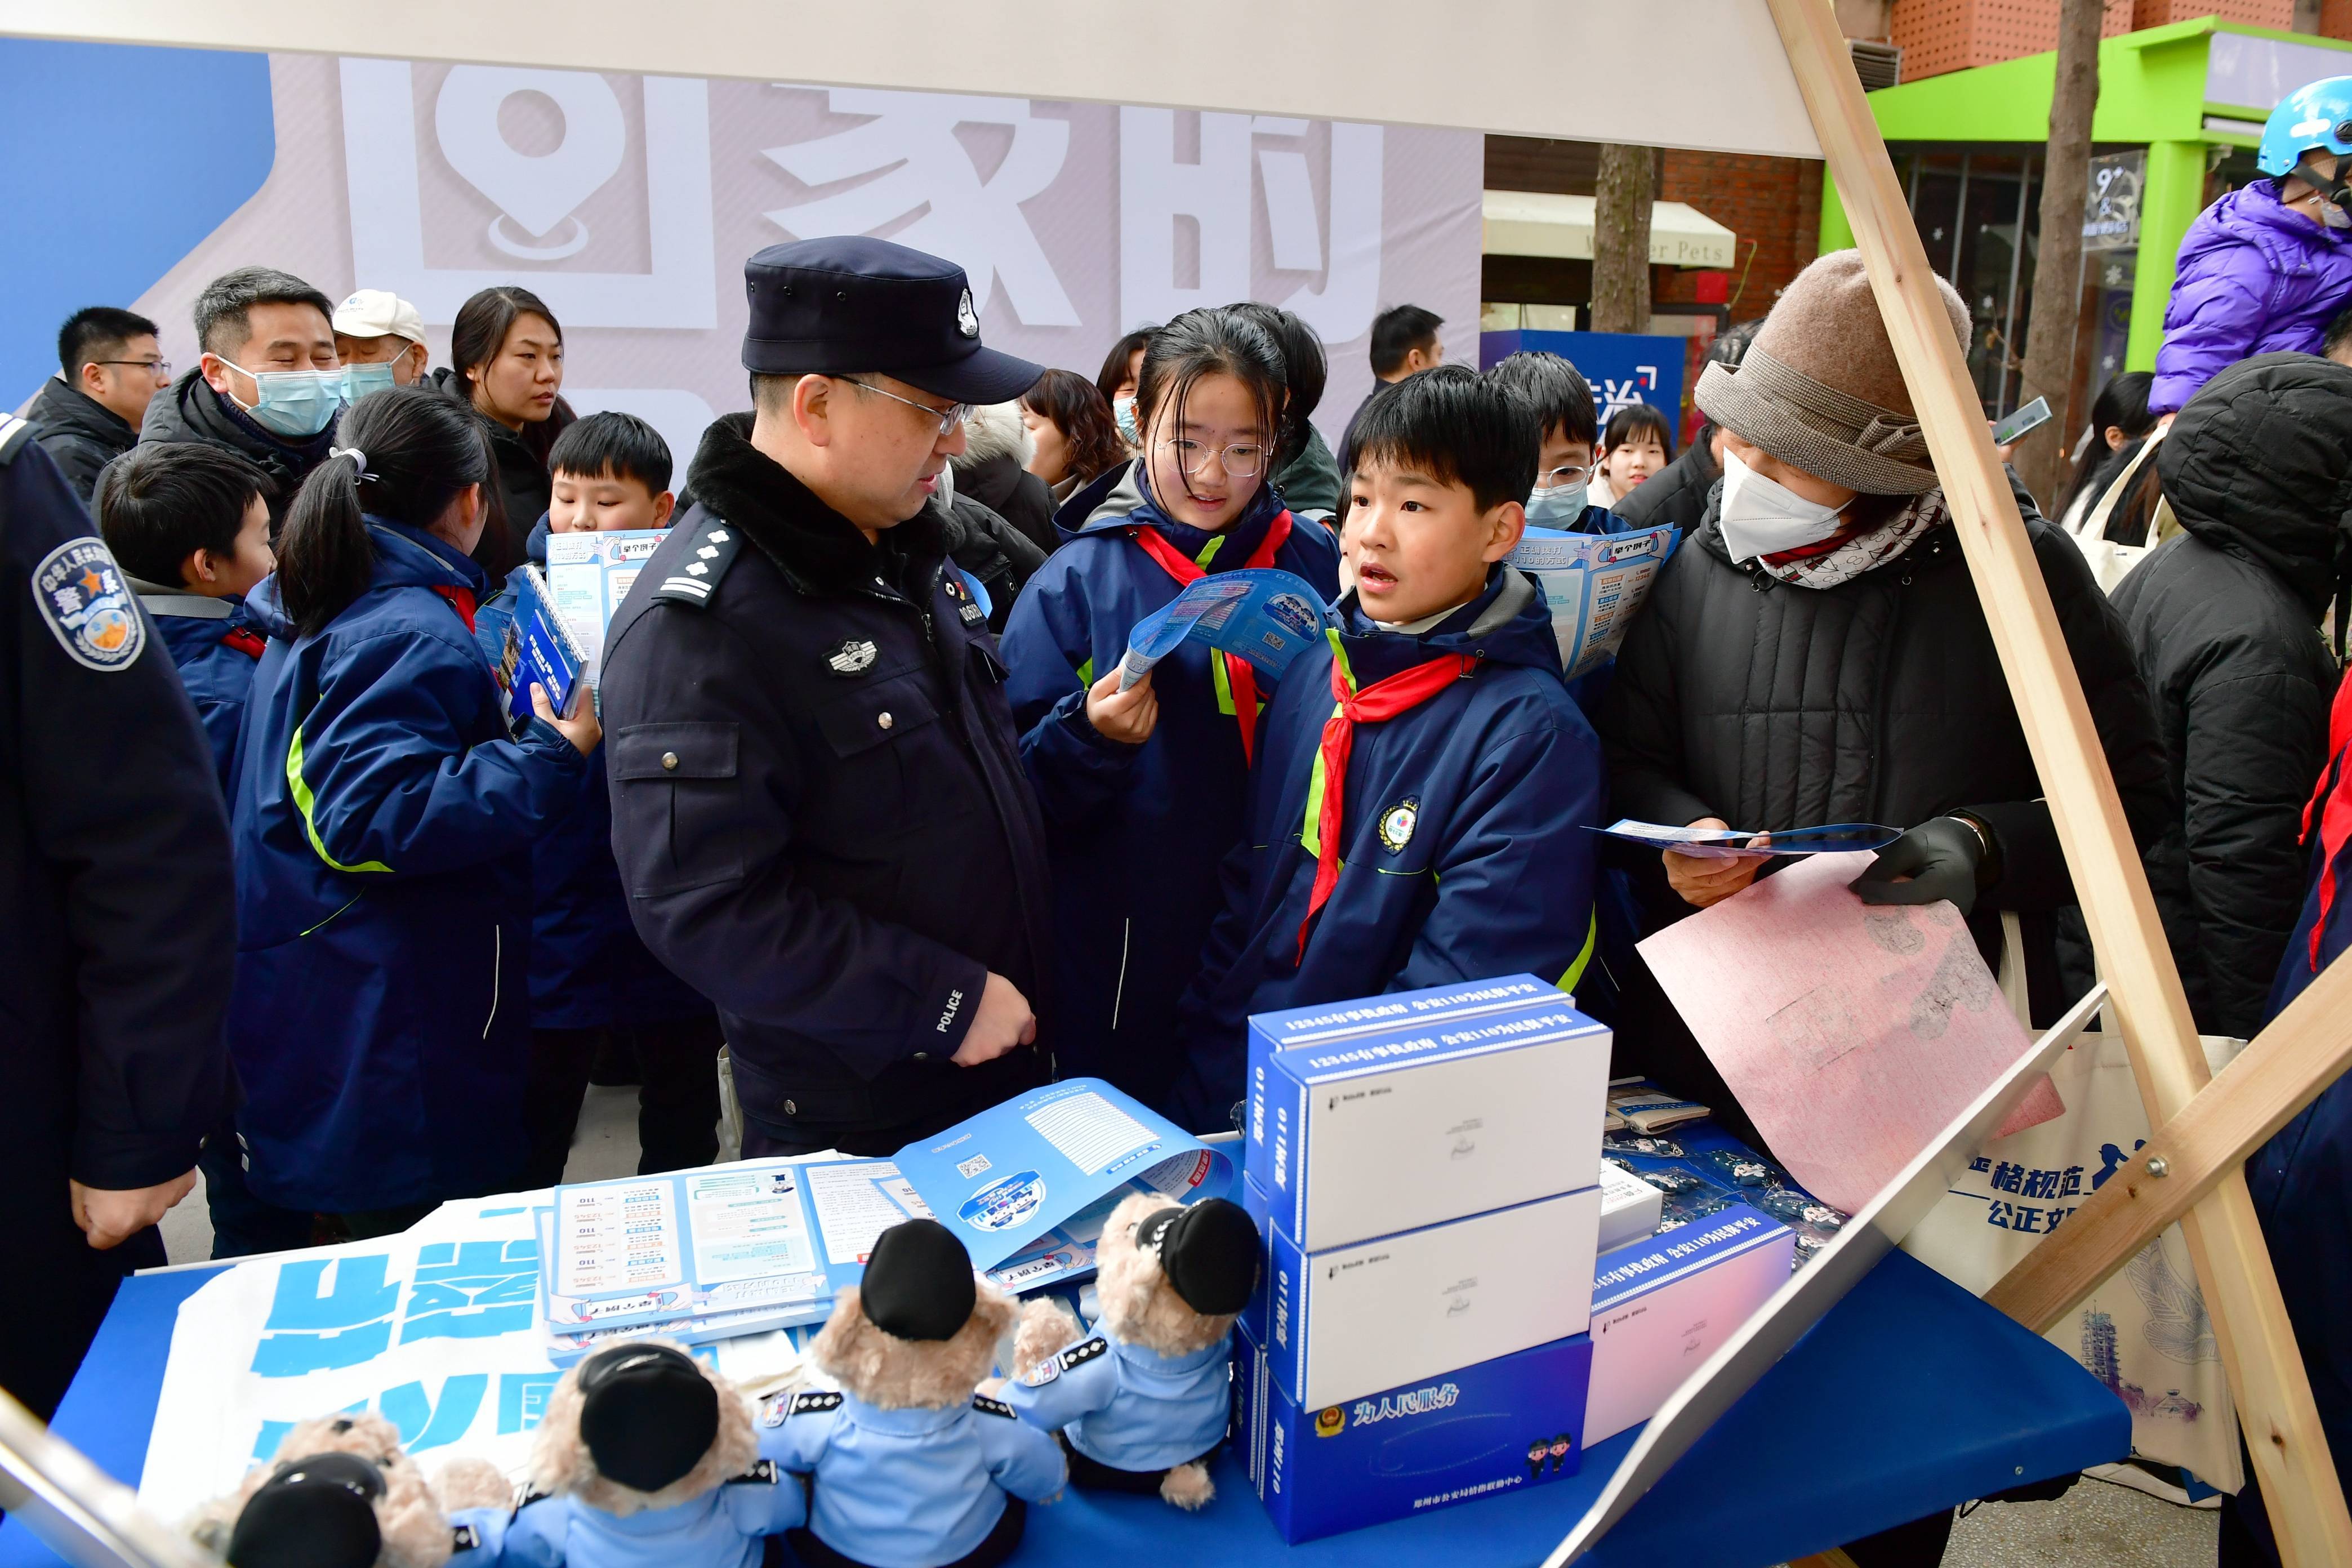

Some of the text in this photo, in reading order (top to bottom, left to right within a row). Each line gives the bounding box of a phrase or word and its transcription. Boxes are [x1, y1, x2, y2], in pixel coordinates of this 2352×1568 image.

[1678, 240, 1723, 261] Pets
[623, 542, 657, 553] 举个例子
[1520, 546, 1563, 555] 正确拨打
[1614, 539, 1652, 555] 举个例子
[1514, 555, 1567, 565] 110的方式
[936, 989, 964, 1033] POLICE
[1666, 1217, 1762, 1259] 公安110为民保平安
[588, 1300, 653, 1317] 举个例子
[1352, 1382, 1460, 1428] 为人民服务
